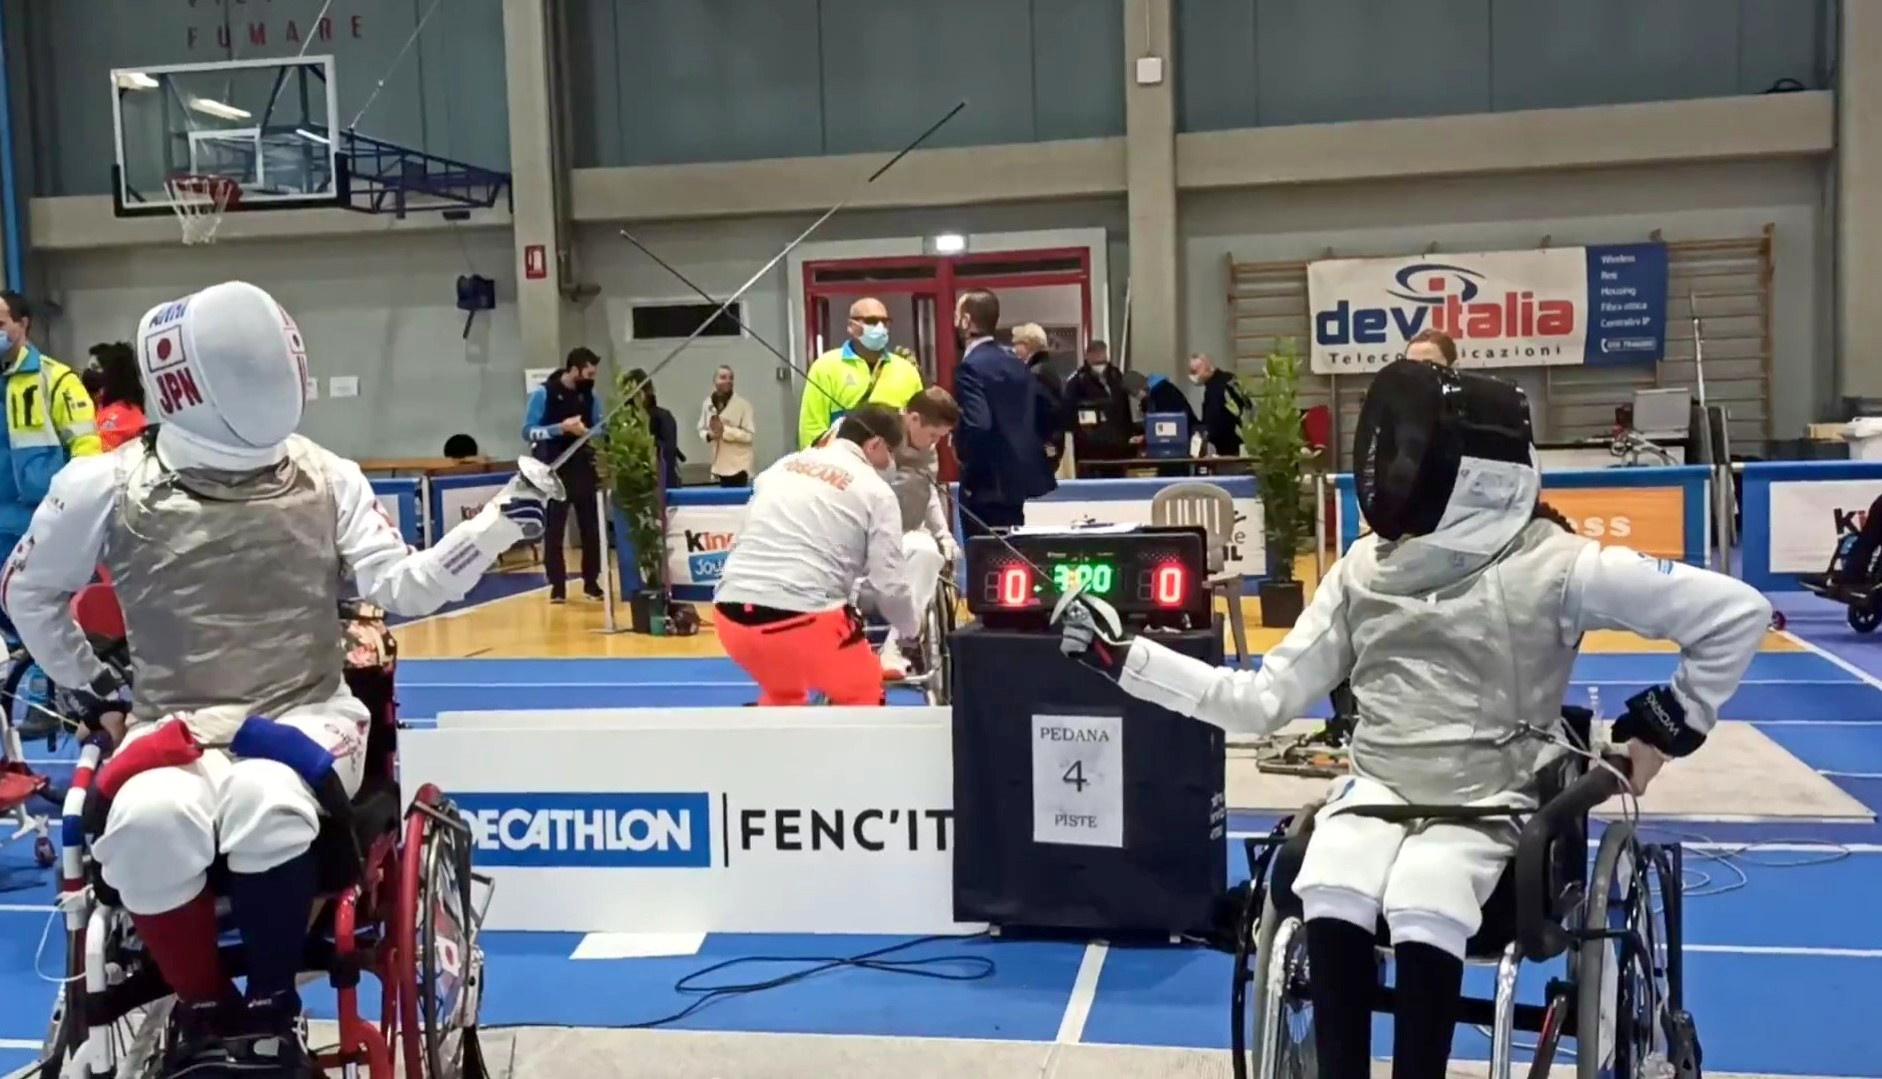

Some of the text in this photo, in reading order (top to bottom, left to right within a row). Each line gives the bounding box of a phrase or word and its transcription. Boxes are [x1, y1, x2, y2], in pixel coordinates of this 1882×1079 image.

[187, 15, 362, 49] FUMARE
[1601, 287, 1636, 297] Housing
[1316, 278, 1573, 345] devitalia
[157, 367, 204, 414] JPN
[1006, 569, 1026, 605] 0
[1159, 567, 1182, 603] 0
[1040, 727, 1110, 742] PEDANA
[1062, 760, 1088, 792] 4
[1055, 814, 1097, 828] PISTE
